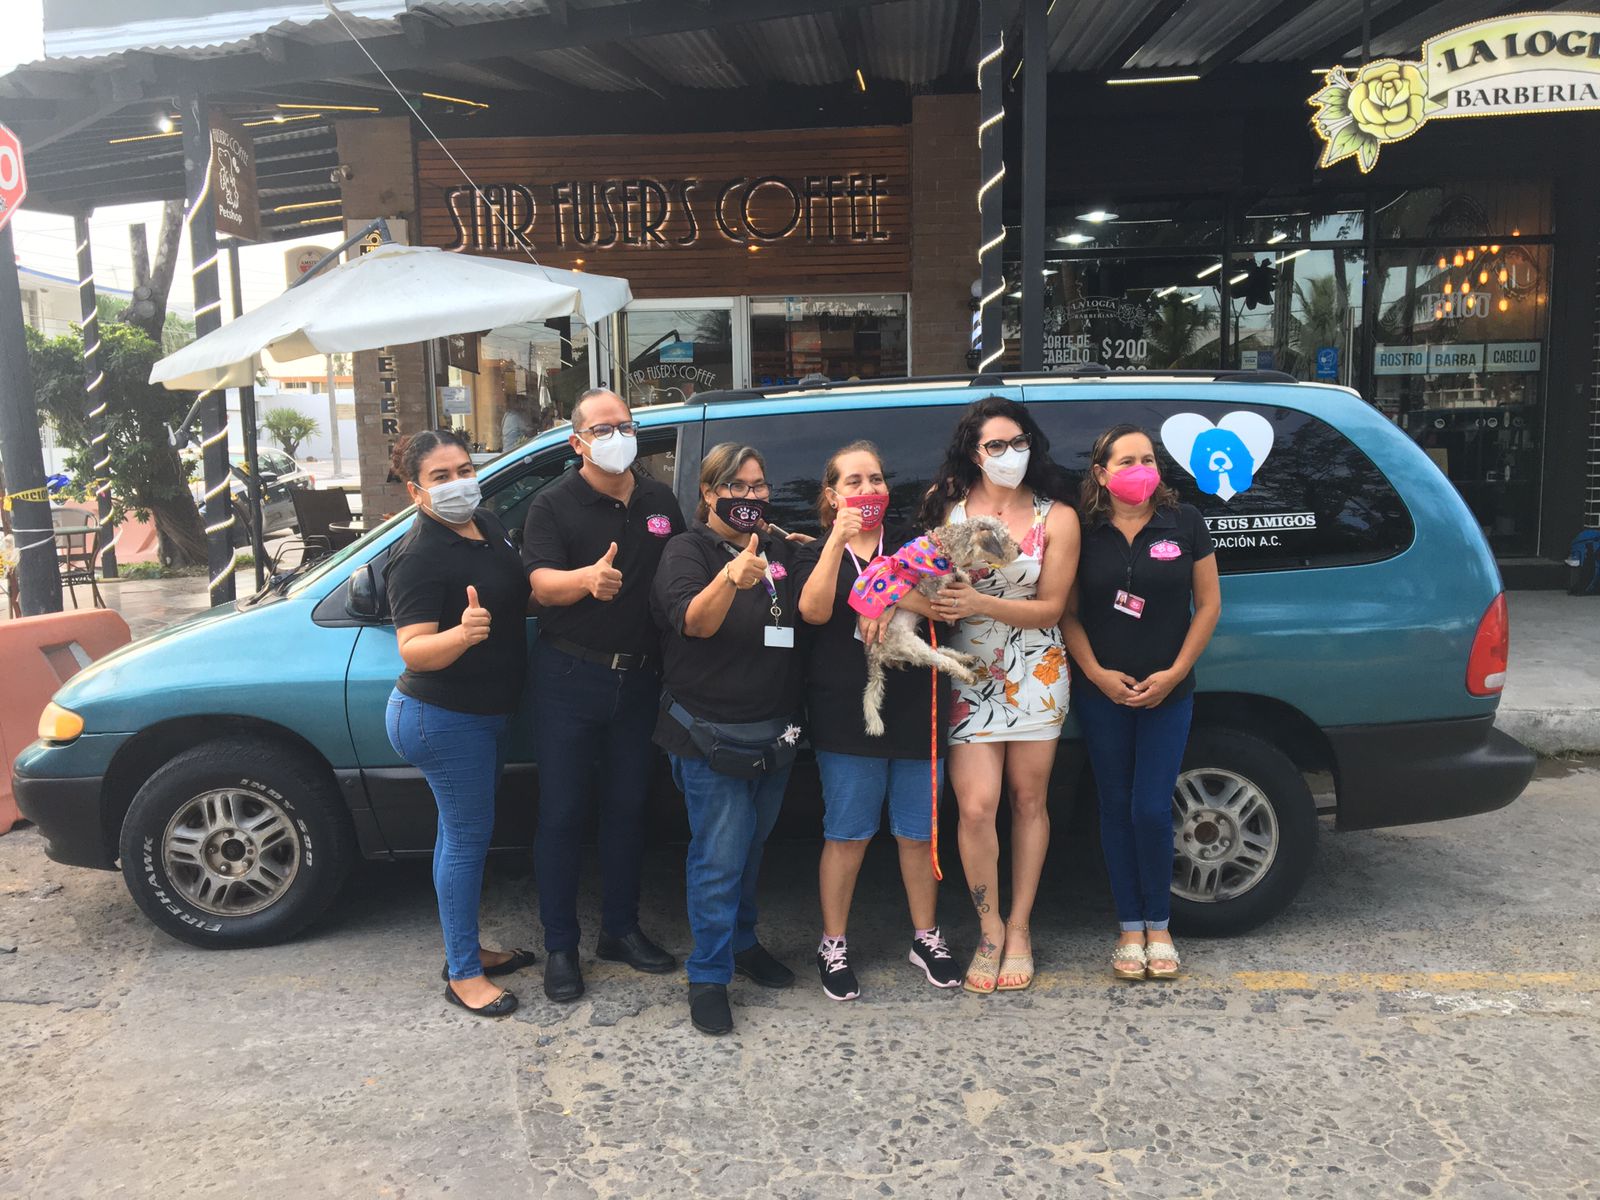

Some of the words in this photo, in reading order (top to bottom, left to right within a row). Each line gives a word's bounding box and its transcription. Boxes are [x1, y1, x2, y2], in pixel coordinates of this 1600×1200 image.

[1441, 39, 1498, 73] LA
[218, 204, 242, 225] Petshop
[444, 183, 538, 252] STAR
[551, 178, 700, 248] FUSER'S
[715, 172, 891, 244] COFFEE
[1076, 334, 1091, 348] DE
[1102, 336, 1148, 360] $200
[1380, 352, 1423, 367] ROSTRO
[1435, 353, 1476, 366] BARBA
[1493, 350, 1536, 364] CABELLO
[679, 365, 716, 388] COFFEE
[1217, 517, 1249, 531] SUS
[1252, 514, 1317, 529] AMIGOS
[1259, 535, 1282, 547] A.C.
[143, 836, 224, 933] FIREHAWK
